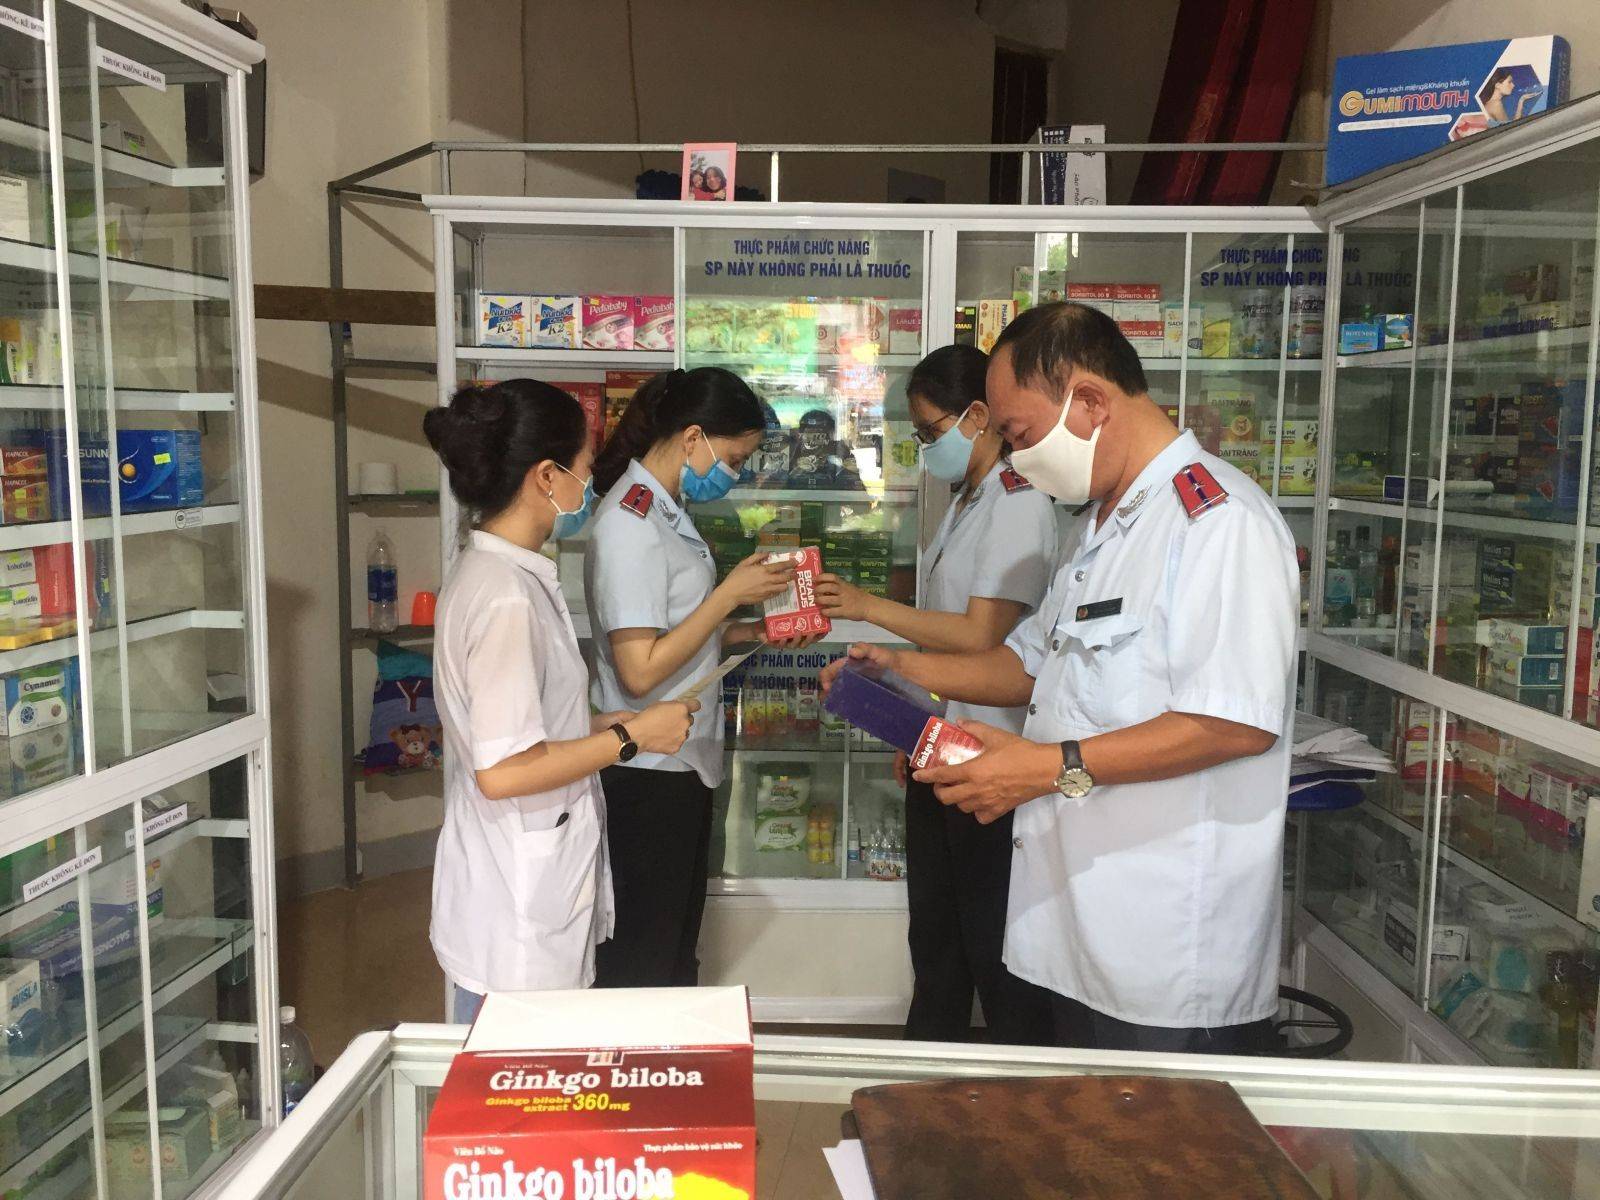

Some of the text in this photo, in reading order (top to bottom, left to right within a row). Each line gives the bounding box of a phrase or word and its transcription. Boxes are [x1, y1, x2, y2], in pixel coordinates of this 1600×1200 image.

[734, 239, 763, 257] THỰC
[804, 238, 833, 255] CHỨC
[705, 258, 911, 279] SP NÀY KHÔNG PHẢI LÀ THUỐC
[1201, 272, 1219, 287] SP
[797, 570, 808, 609] FOCUS
[804, 569, 815, 607] BRAIN
[797, 651, 827, 668] CHỨC
[916, 721, 943, 768] Ginkgo biloba
[489, 1067, 704, 1095] Ginkgo biloba
[485, 1096, 530, 1106] Ginkgo
[532, 1096, 572, 1105] biloba
[523, 1103, 568, 1113] extract
[443, 1156, 675, 1200] Ginkgo biloba
